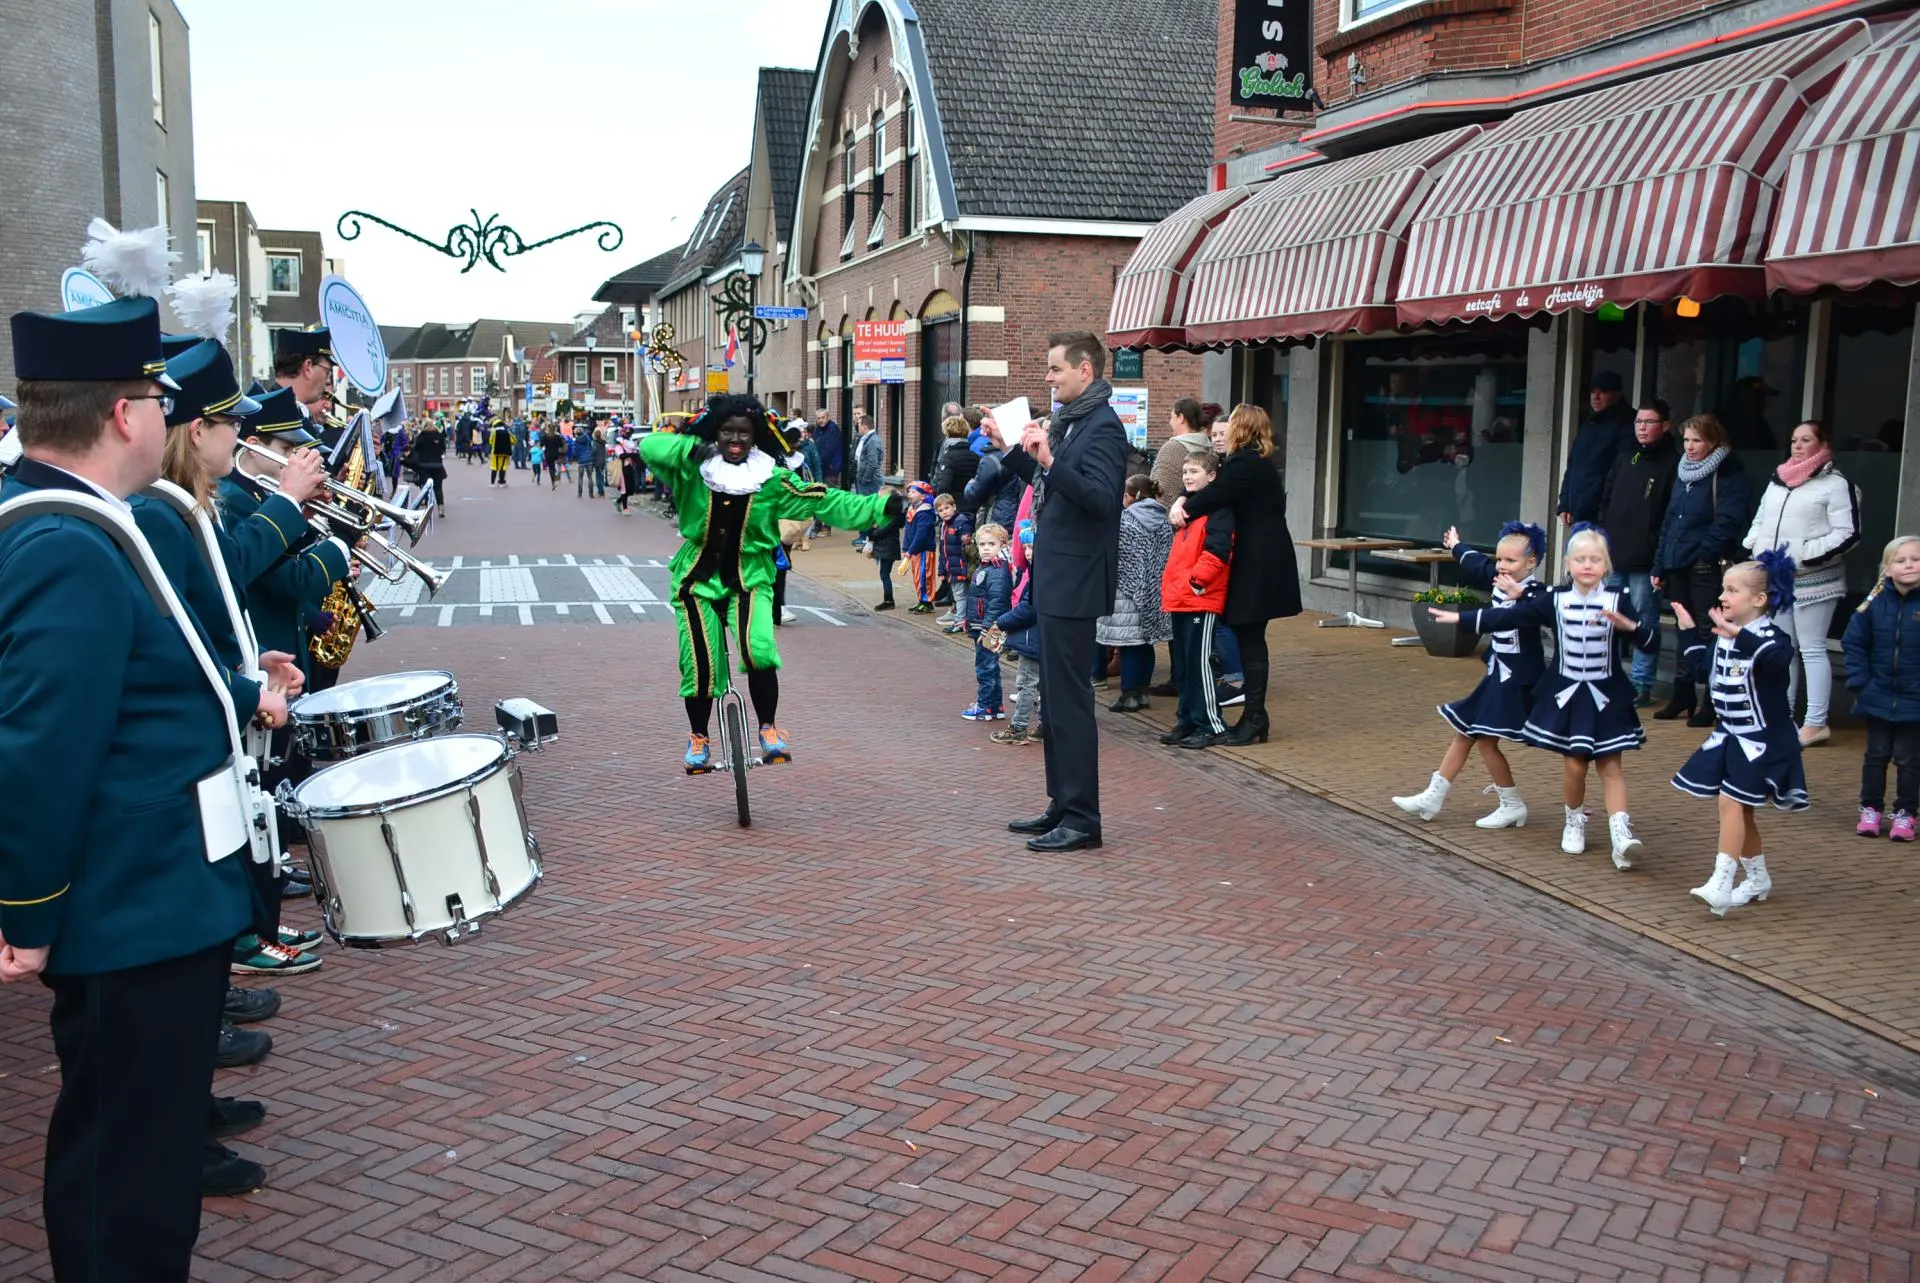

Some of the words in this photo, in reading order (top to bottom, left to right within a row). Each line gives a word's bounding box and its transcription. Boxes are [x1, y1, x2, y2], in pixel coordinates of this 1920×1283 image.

[1239, 66, 1305, 99] Grolsch
[328, 300, 370, 326] AMICITIA
[1465, 293, 1502, 316] eetcafé
[1516, 290, 1529, 307] de
[1545, 284, 1604, 309] Harlekijn
[857, 324, 871, 337] TE
